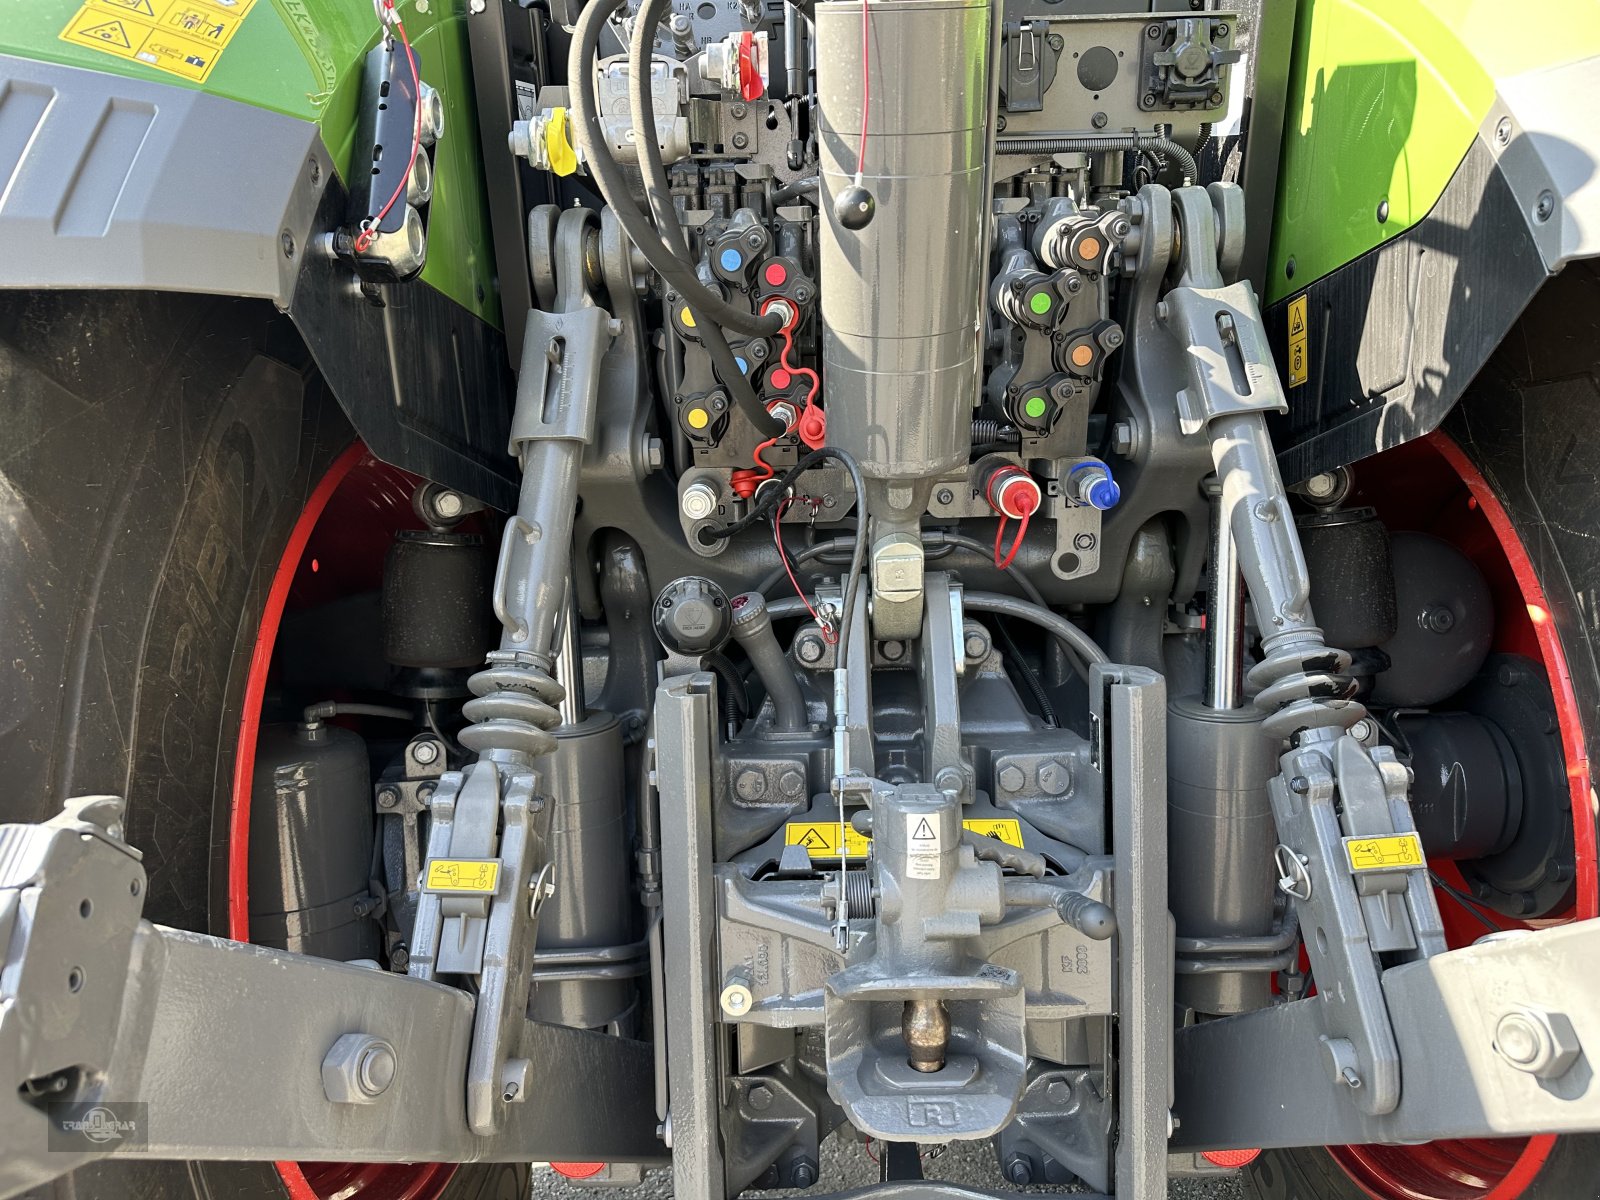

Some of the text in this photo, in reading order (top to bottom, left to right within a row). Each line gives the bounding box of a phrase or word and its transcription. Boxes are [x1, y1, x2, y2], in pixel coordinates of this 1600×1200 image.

[972, 488, 980, 501] P
[1065, 496, 1081, 509] LS
[718, 504, 726, 516] D
